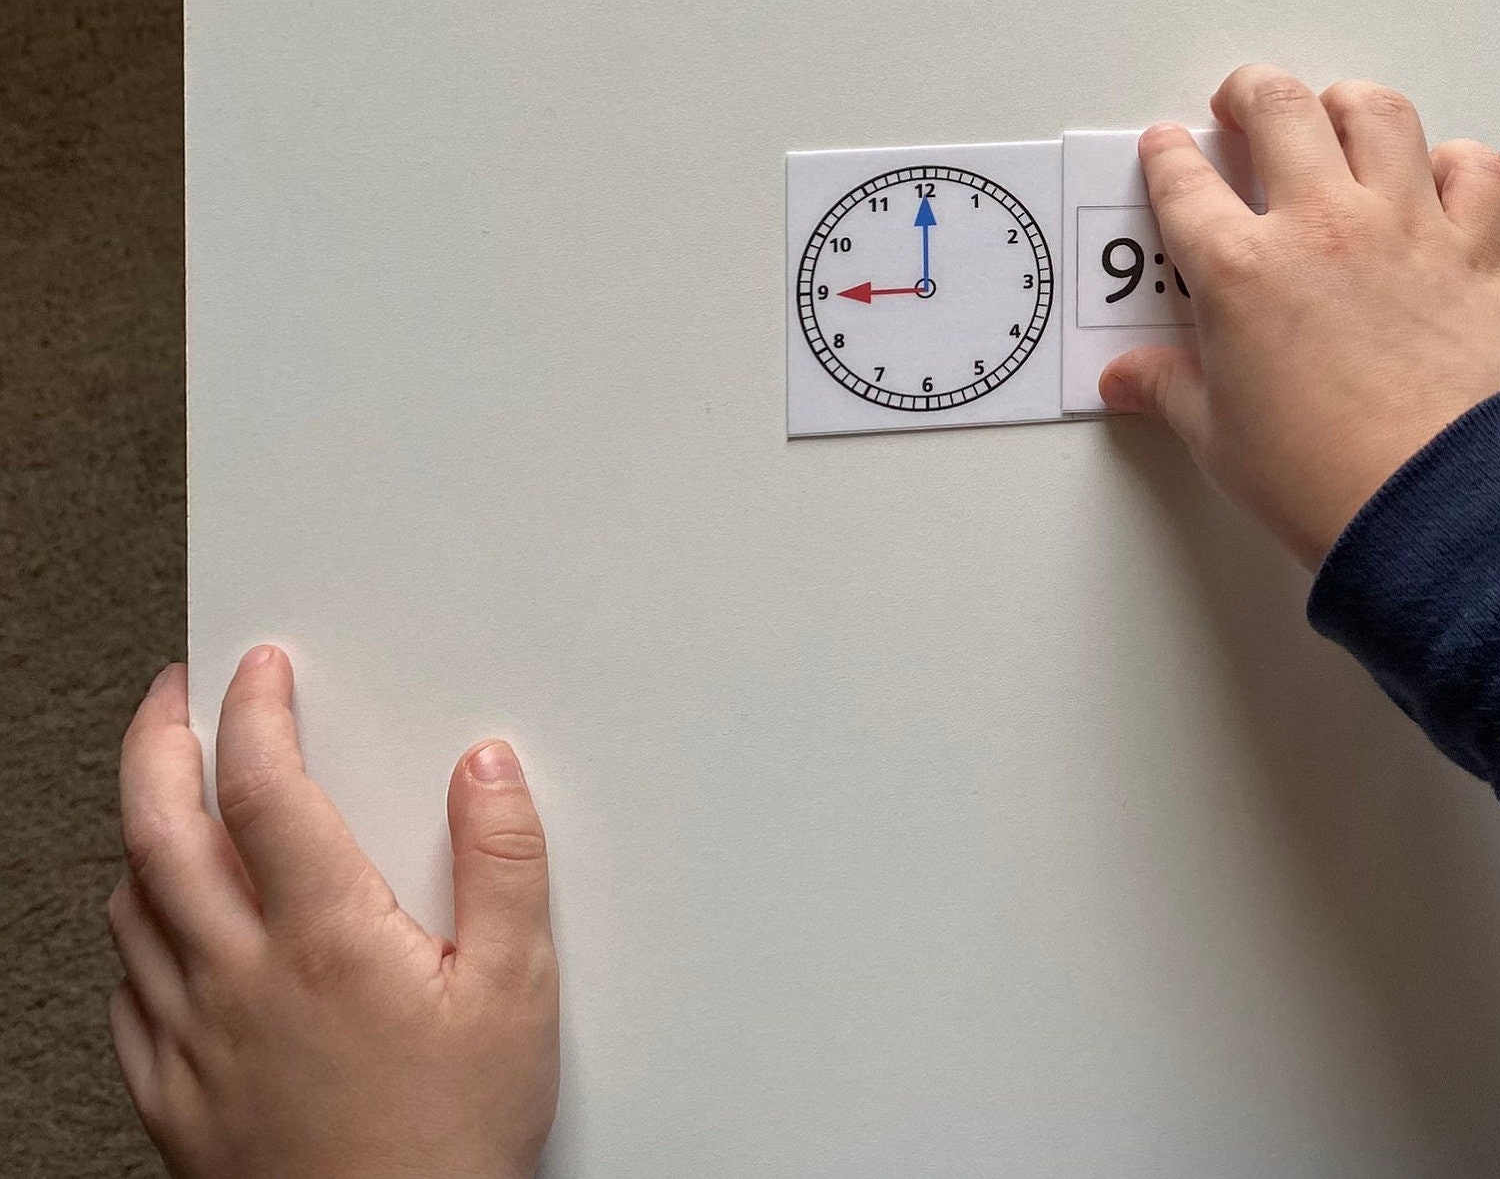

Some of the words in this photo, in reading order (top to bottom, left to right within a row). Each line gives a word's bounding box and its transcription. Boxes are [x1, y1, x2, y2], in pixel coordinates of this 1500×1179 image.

[914, 182, 936, 200] 12
[868, 196, 888, 213] 11
[970, 193, 979, 209] 1
[829, 237, 852, 253] 10
[1007, 228, 1019, 245] 2
[1102, 237, 1191, 303] 9:
[1022, 273, 1034, 290] 3
[817, 284, 829, 301] 9
[1008, 323, 1022, 339] 4
[833, 333, 845, 349] 8
[873, 366, 885, 383] 7
[974, 359, 985, 376] 5
[921, 376, 934, 393] 6
